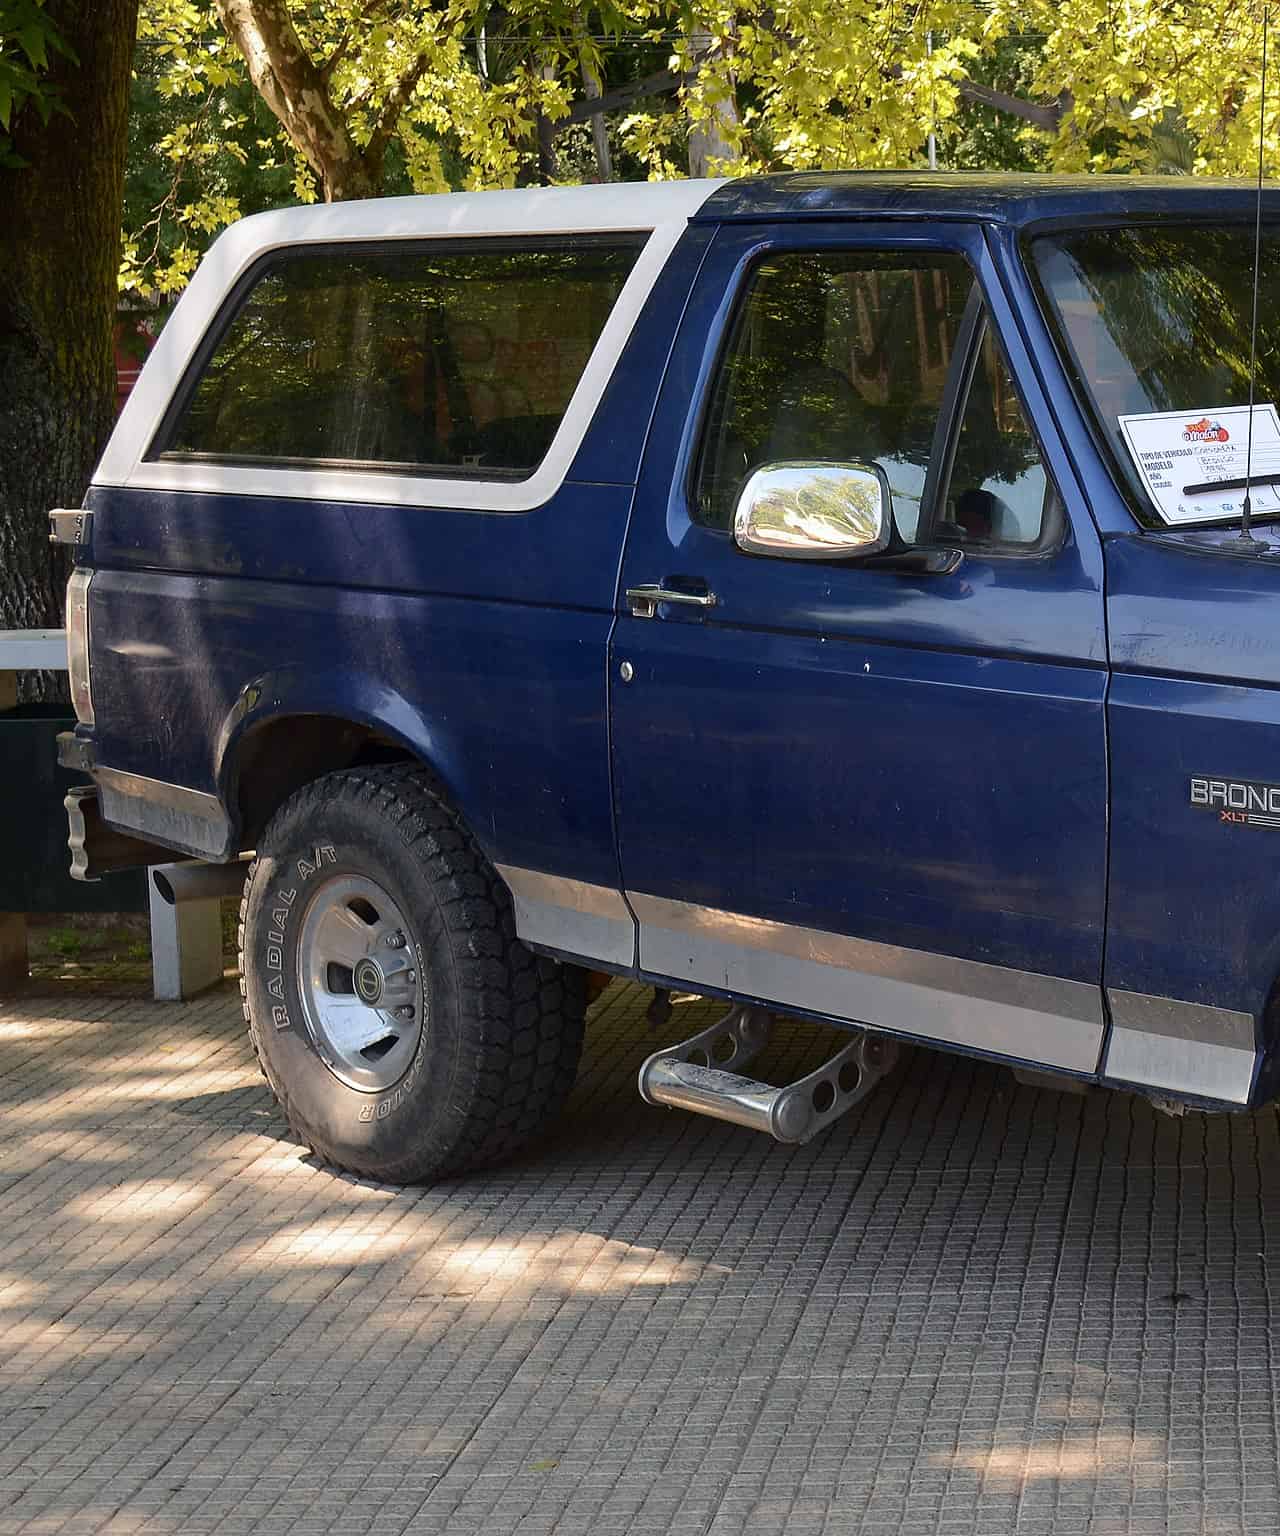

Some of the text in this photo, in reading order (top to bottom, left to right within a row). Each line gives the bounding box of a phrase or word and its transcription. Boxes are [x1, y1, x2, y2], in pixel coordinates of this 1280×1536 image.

[1220, 810, 1248, 823] XLT
[267, 845, 337, 1030] RADIAL A/T
